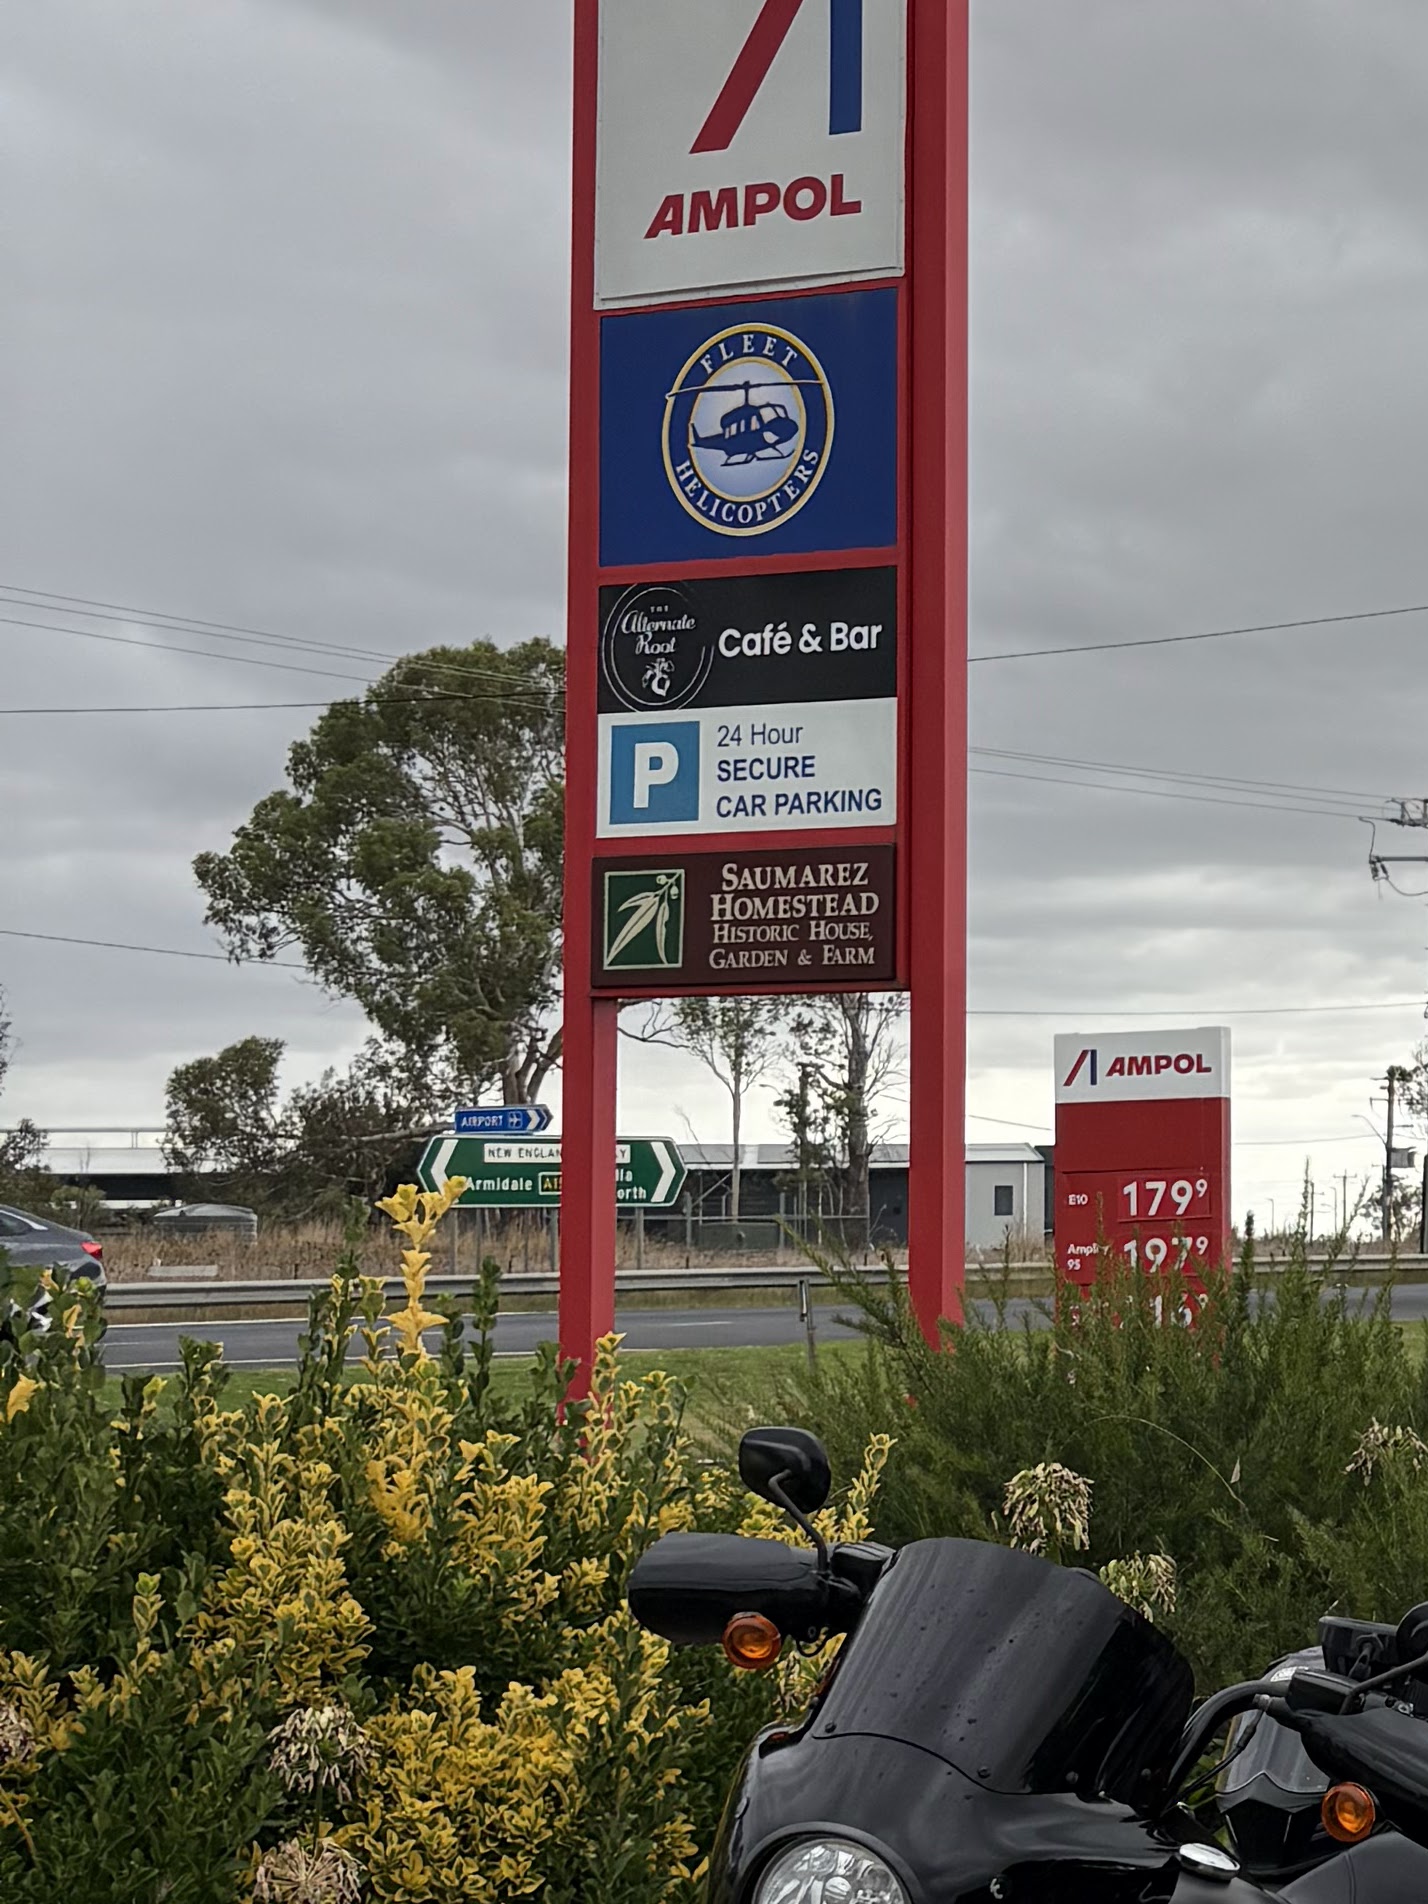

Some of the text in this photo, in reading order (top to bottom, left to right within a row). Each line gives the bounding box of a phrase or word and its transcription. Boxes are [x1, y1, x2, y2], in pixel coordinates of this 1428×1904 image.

[643, 174, 862, 239] AMPOL
[700, 334, 797, 375] FLEET
[676, 449, 819, 524] HELICOPTERS
[621, 609, 697, 635] Alternate
[635, 632, 677, 655] Root
[718, 622, 883, 658] Café & Bar
[717, 723, 803, 747] 24 Hour
[633, 741, 679, 809] P
[717, 755, 816, 782] SECURE
[716, 788, 882, 818] CAR PARKING
[721, 862, 869, 891] SAUMAREZ
[710, 892, 880, 921] HOMESTEAD
[713, 920, 873, 944] HISTORIC HOUSE,
[709, 944, 875, 969] GARDEN & FARM
[1106, 1053, 1212, 1077] AMPOL
[461, 1115, 503, 1127] AIRPORT
[488, 1146, 561, 1159] NEW ENGLAN
[466, 1177, 533, 1191] Armidale
[1068, 1194, 1088, 1206] E10
[1067, 1259, 1081, 1271] 95
